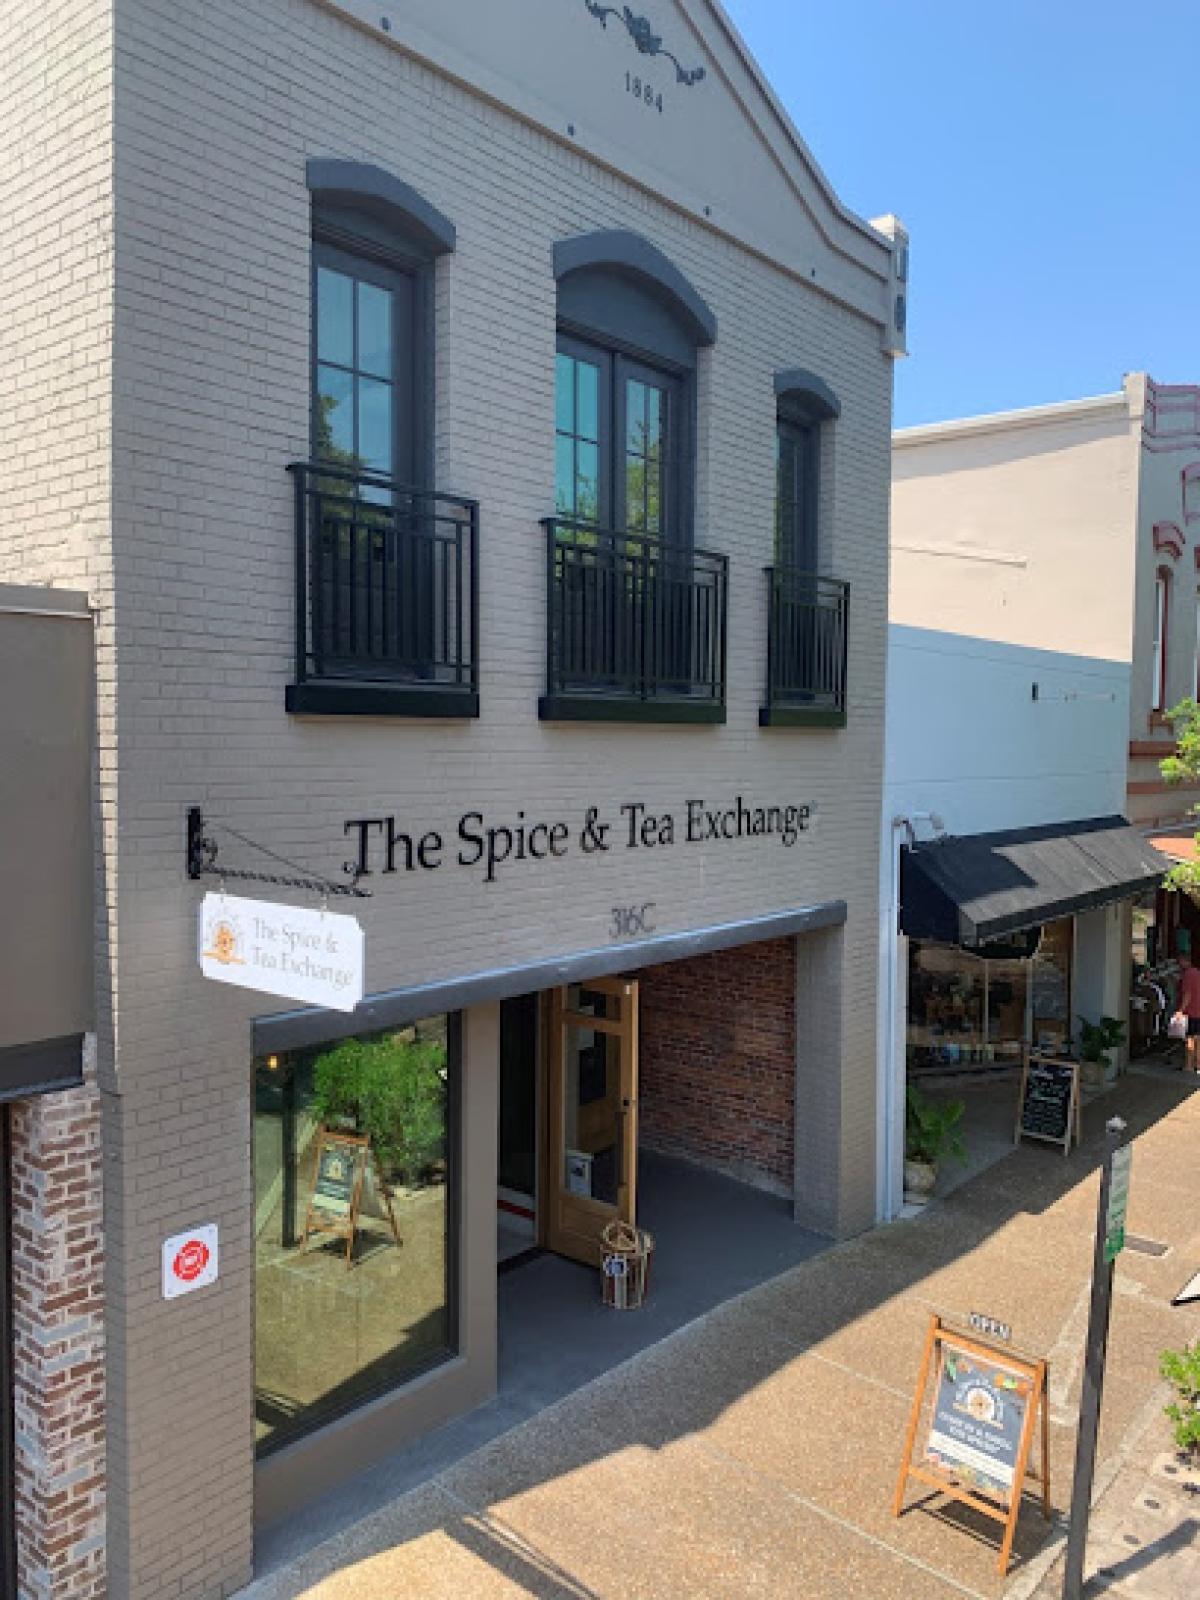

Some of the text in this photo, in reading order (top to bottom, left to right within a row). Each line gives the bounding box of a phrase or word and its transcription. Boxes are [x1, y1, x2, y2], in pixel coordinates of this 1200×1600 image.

[344, 796, 810, 883] The Spice & Tea Exchange
[253, 917, 338, 954] The Spice &
[607, 902, 657, 939] 316C
[251, 946, 354, 991] Tea Exchange
